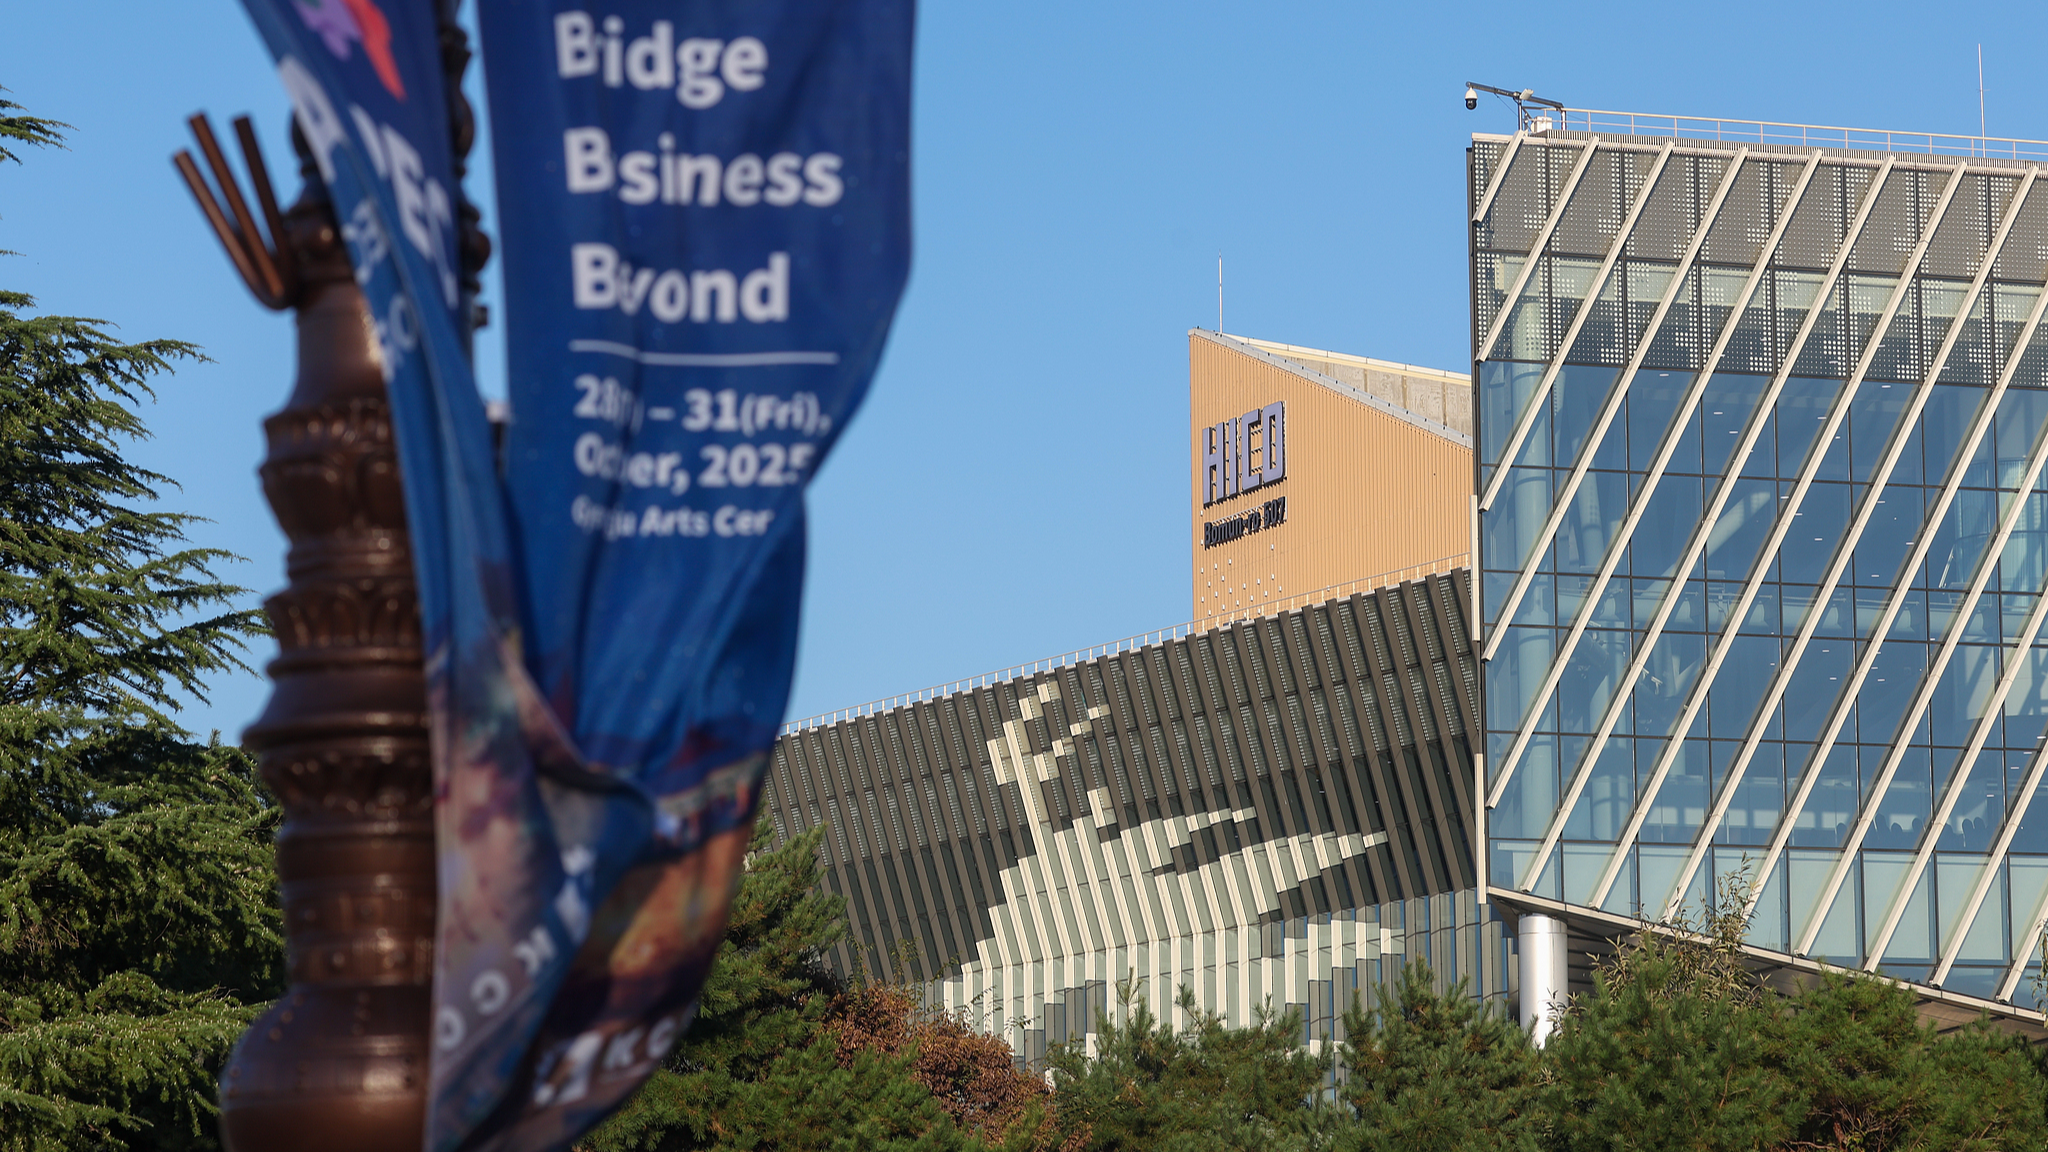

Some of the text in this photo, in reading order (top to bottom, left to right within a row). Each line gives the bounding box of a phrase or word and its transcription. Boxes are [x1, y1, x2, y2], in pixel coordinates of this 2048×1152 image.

[553, 10, 769, 109] Bidge
[563, 125, 845, 207] Bsiness
[1202, 400, 1286, 507] HICO
[1204, 496, 1286, 548] Bomun-ro 507
